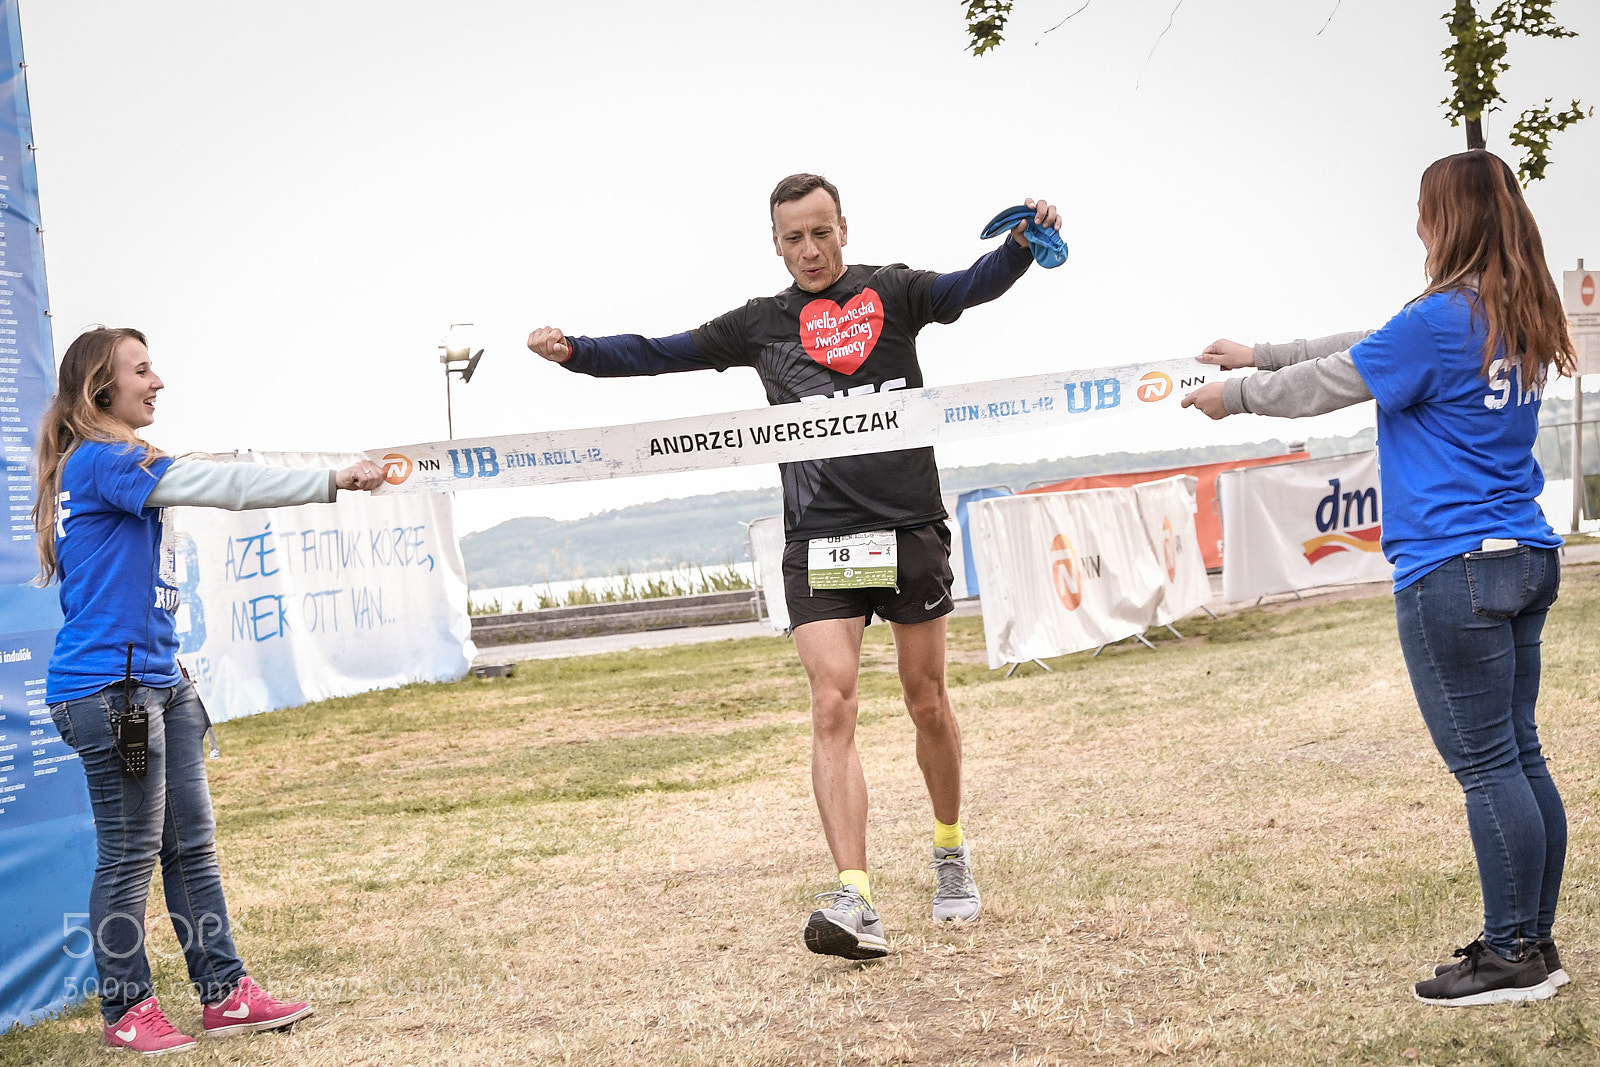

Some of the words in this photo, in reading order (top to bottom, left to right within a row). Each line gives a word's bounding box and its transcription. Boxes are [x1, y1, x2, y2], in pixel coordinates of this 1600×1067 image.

[806, 311, 837, 331] wielka
[826, 340, 865, 364] pomocy
[1064, 377, 1122, 414] UB
[1180, 375, 1206, 389] NN
[650, 428, 744, 456] ANDRZEJ
[749, 410, 900, 445] WERESZCZAK
[417, 459, 440, 471] NN
[447, 446, 500, 478] UB
[1315, 478, 1379, 533] dm
[828, 548, 851, 563] 18
